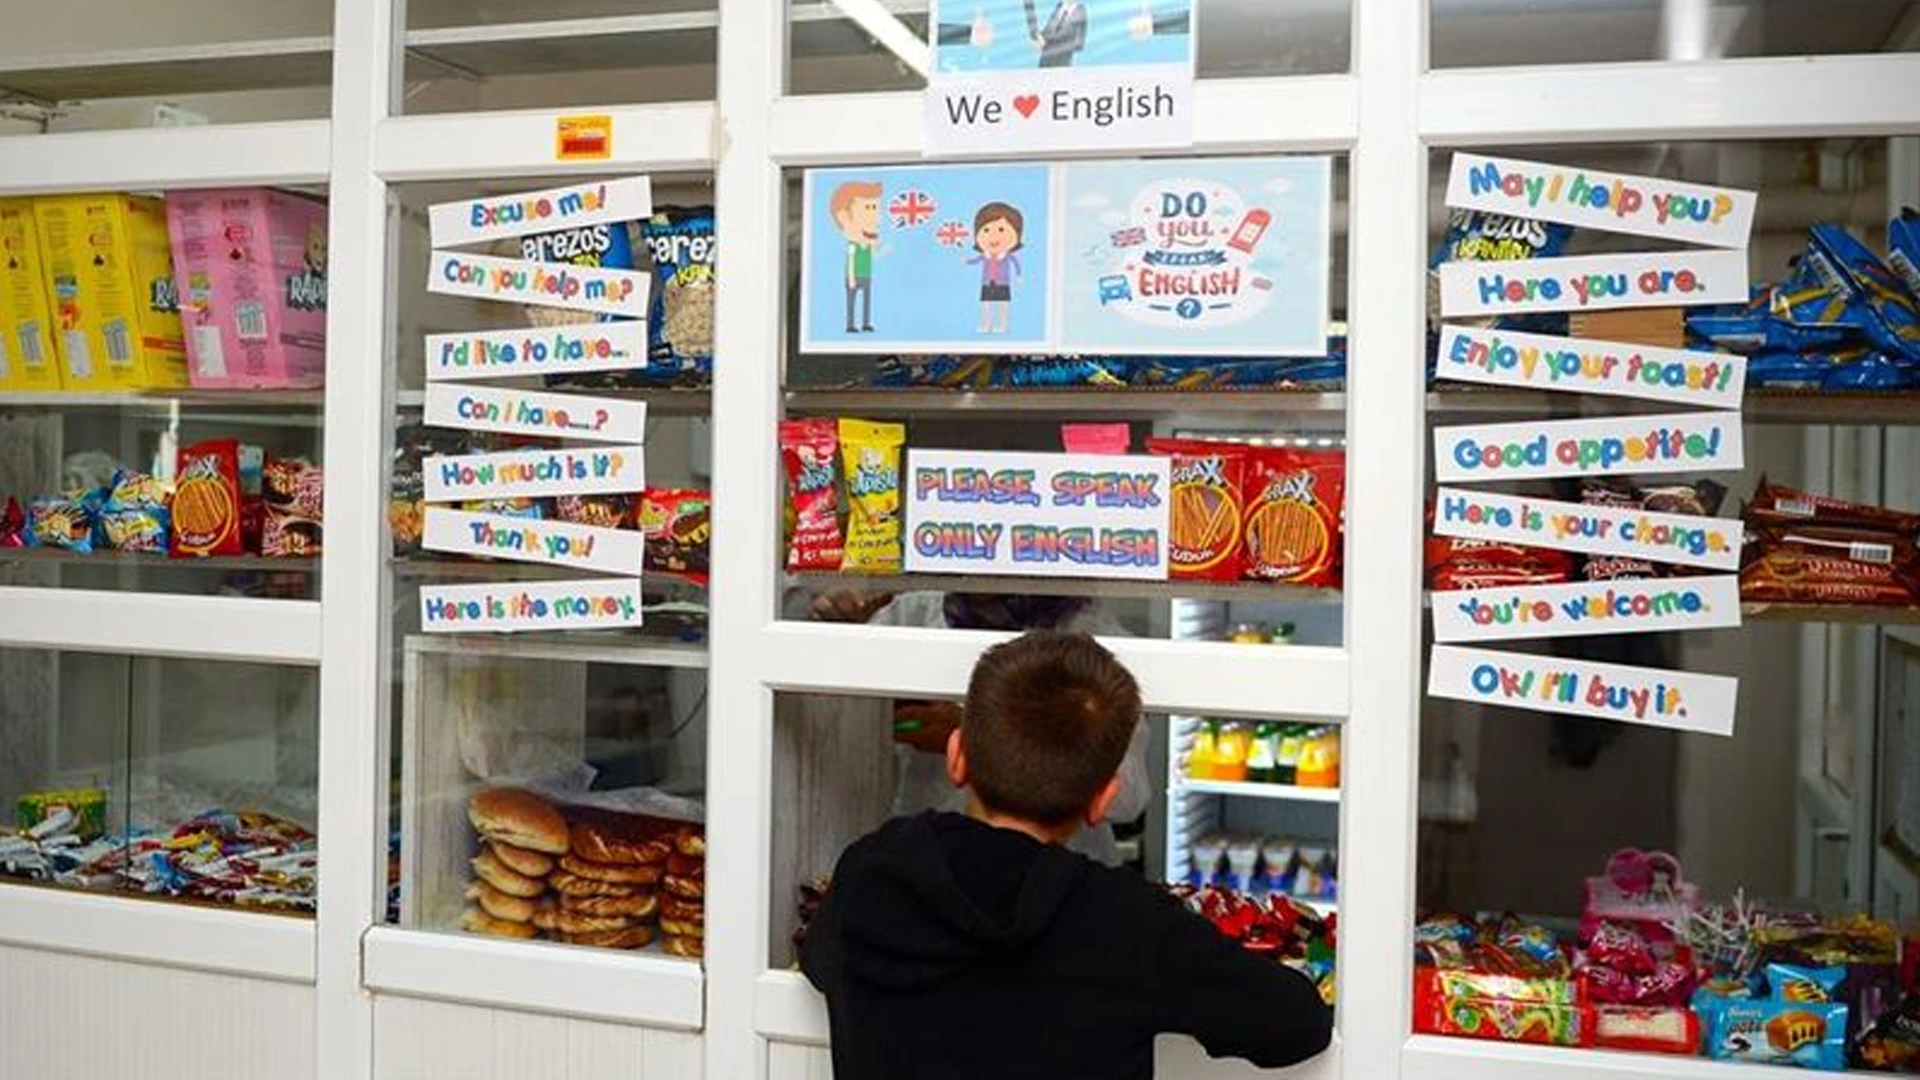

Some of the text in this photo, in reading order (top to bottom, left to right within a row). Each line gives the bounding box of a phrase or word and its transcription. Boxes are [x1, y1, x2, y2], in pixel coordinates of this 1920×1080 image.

[946, 86, 1173, 126] We English
[471, 185, 606, 228] Excuse me!
[1162, 191, 1207, 218] DO
[1469, 162, 1733, 224] May I help you?
[1157, 220, 1214, 248] you
[444, 259, 633, 303] Can you help me?
[1139, 266, 1240, 296] ENGLISH
[1478, 269, 1706, 308] Here you are.
[442, 341, 469, 366] I'd
[474, 340, 517, 365] like
[522, 339, 548, 362] to
[1450, 336, 1732, 391] Enjoy your toast!
[458, 397, 499, 422] Can
[504, 402, 513, 421] I
[1454, 426, 1721, 470] Good appetite!
[441, 462, 494, 486] How
[498, 455, 562, 484] much
[567, 455, 587, 479] is
[593, 453, 623, 477] it?
[916, 467, 1041, 507] PLEASE,
[1051, 471, 1161, 509] SPEAK
[470, 521, 594, 558] Thank you!
[914, 521, 1004, 560] ONLY
[1011, 524, 1159, 567] ENGLISH
[1444, 499, 1731, 555] Here is your change.
[426, 593, 635, 621] Here is the money.
[1458, 589, 1711, 625] You're welcome.
[1471, 664, 1687, 718] OK! I'll buy it.
